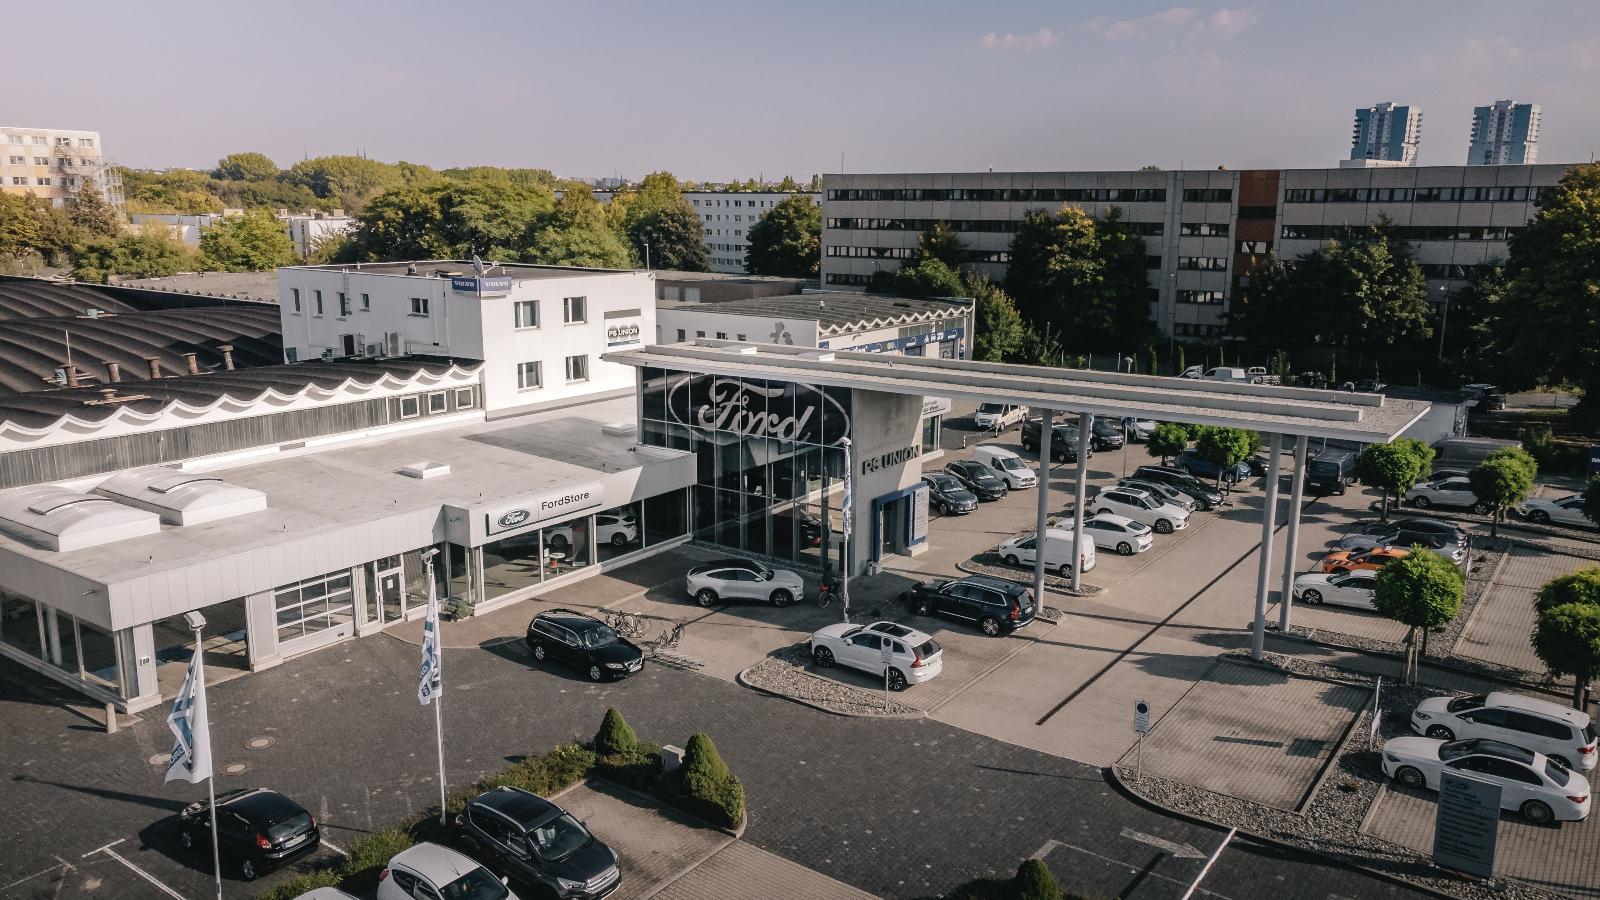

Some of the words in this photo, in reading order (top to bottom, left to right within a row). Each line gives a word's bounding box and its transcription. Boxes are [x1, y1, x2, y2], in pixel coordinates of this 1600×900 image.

[454, 280, 475, 288] VOLVO
[618, 327, 638, 336] UNION
[698, 378, 815, 443] Ford
[862, 457, 879, 475] PS
[881, 444, 920, 469] UNION
[541, 492, 590, 510] FordStore
[504, 511, 526, 525] Ford
